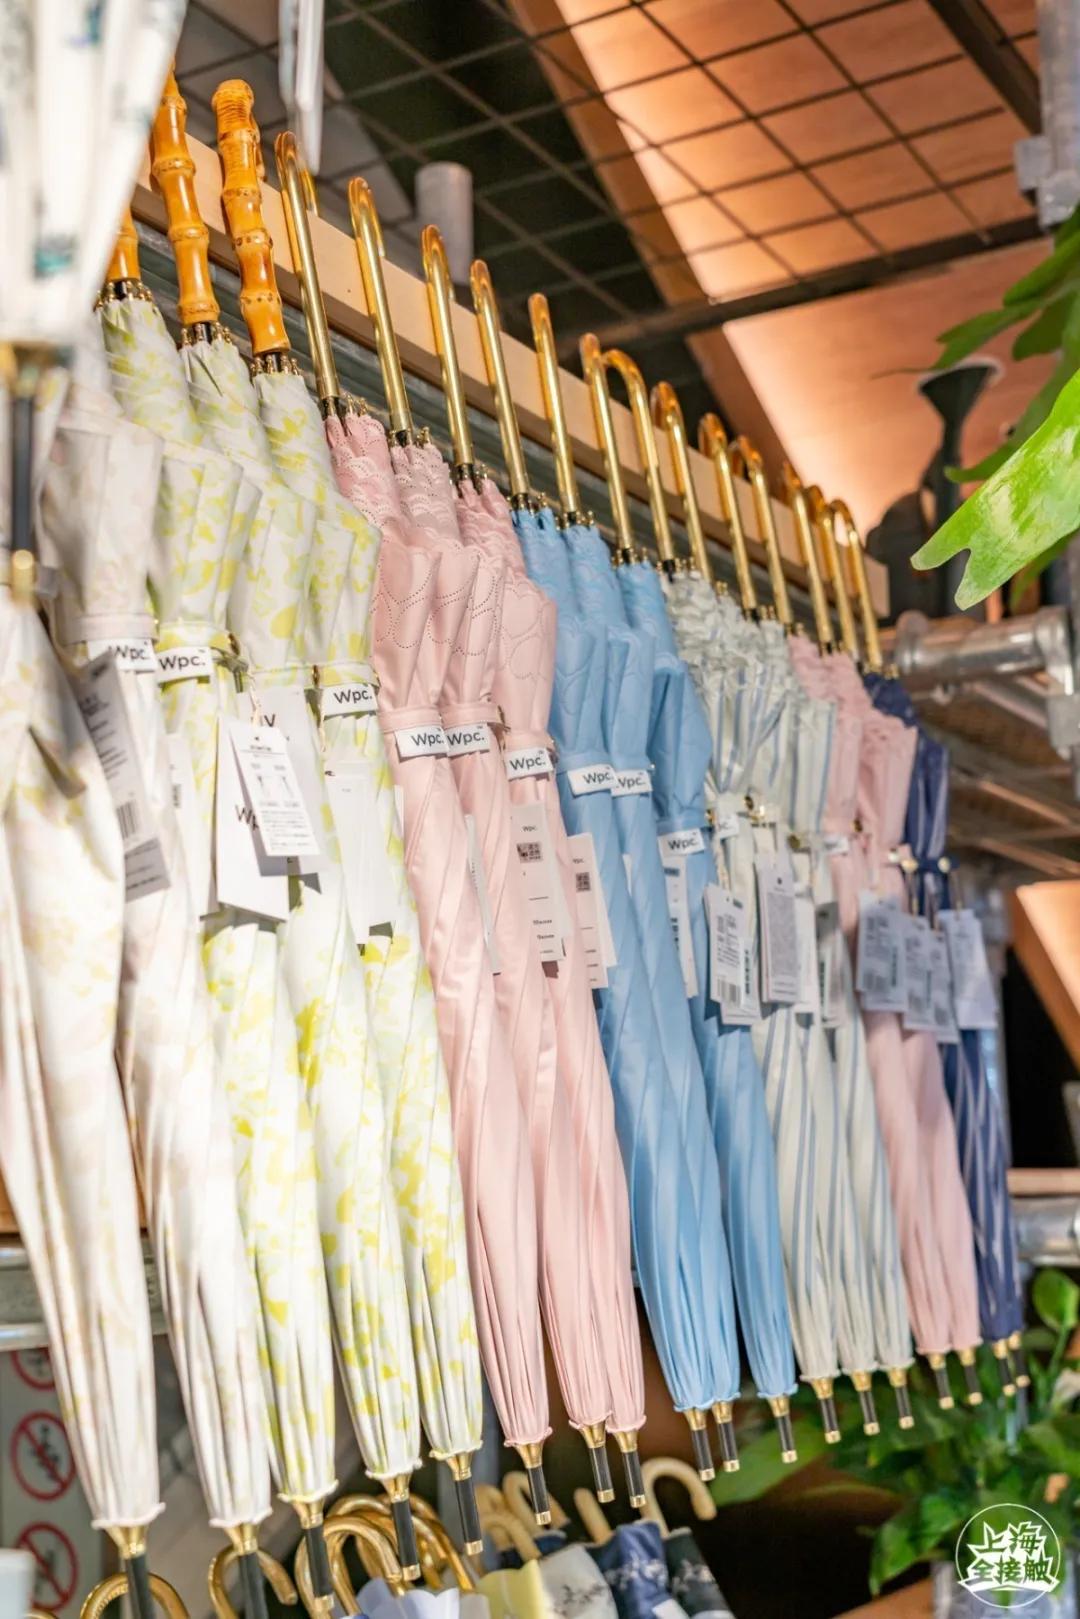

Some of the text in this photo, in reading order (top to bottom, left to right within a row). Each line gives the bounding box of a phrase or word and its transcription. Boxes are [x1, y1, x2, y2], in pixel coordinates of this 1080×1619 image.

[159, 654, 206, 672] Wpc.
[333, 687, 373, 704] Wpc.
[411, 732, 445, 747] Wpc.
[446, 731, 485, 746] Wpc.
[509, 755, 546, 771] Wpc.
[582, 770, 614, 786] Wpc.
